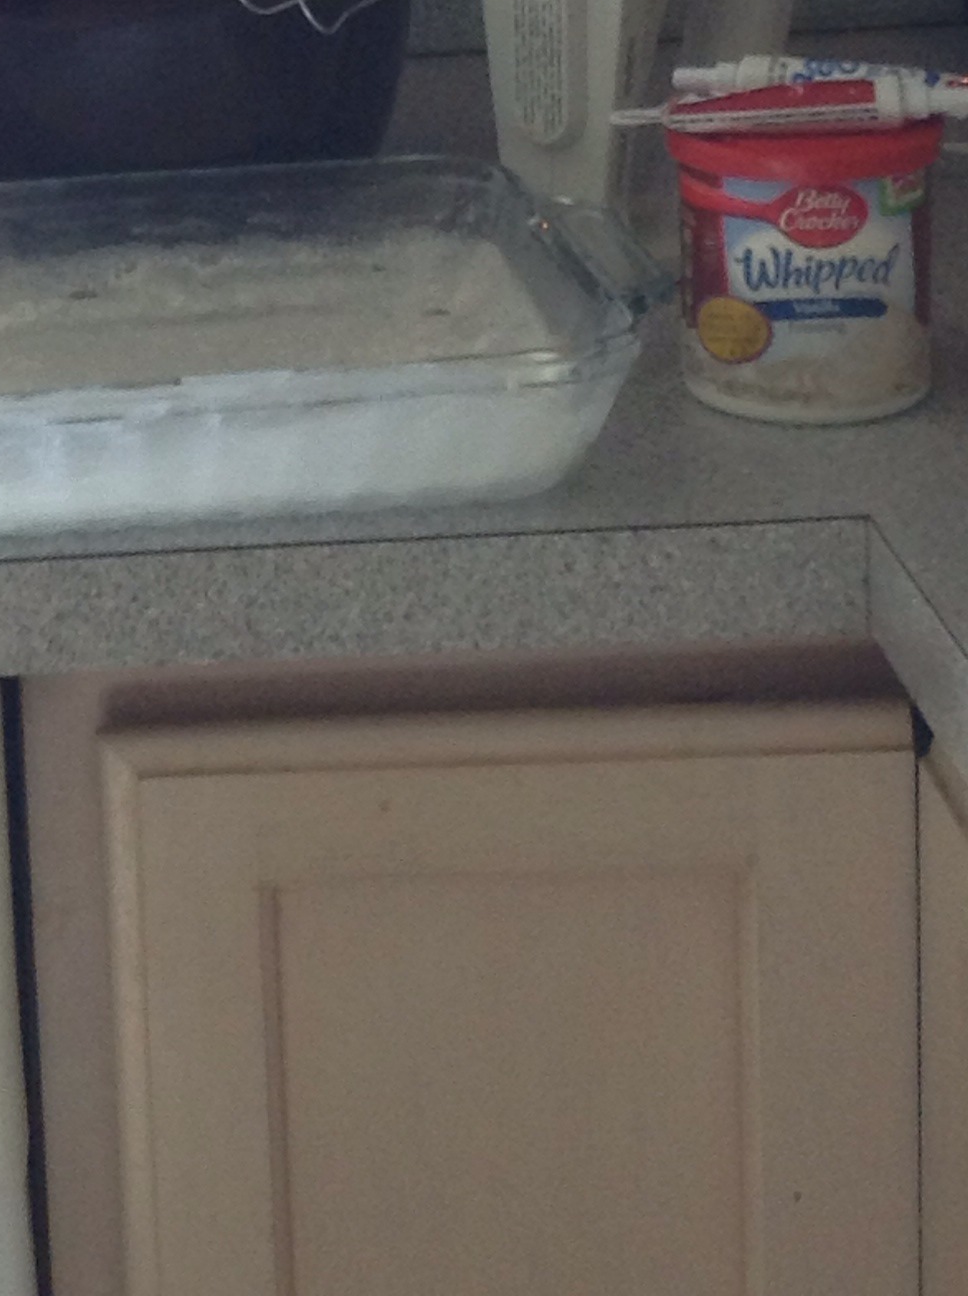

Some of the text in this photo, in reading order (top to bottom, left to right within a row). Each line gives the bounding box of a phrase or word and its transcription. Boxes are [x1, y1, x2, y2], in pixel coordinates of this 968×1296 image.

[794, 189, 851, 214] Betty
[779, 206, 860, 232] Crocker
[734, 243, 900, 291] Whipped
